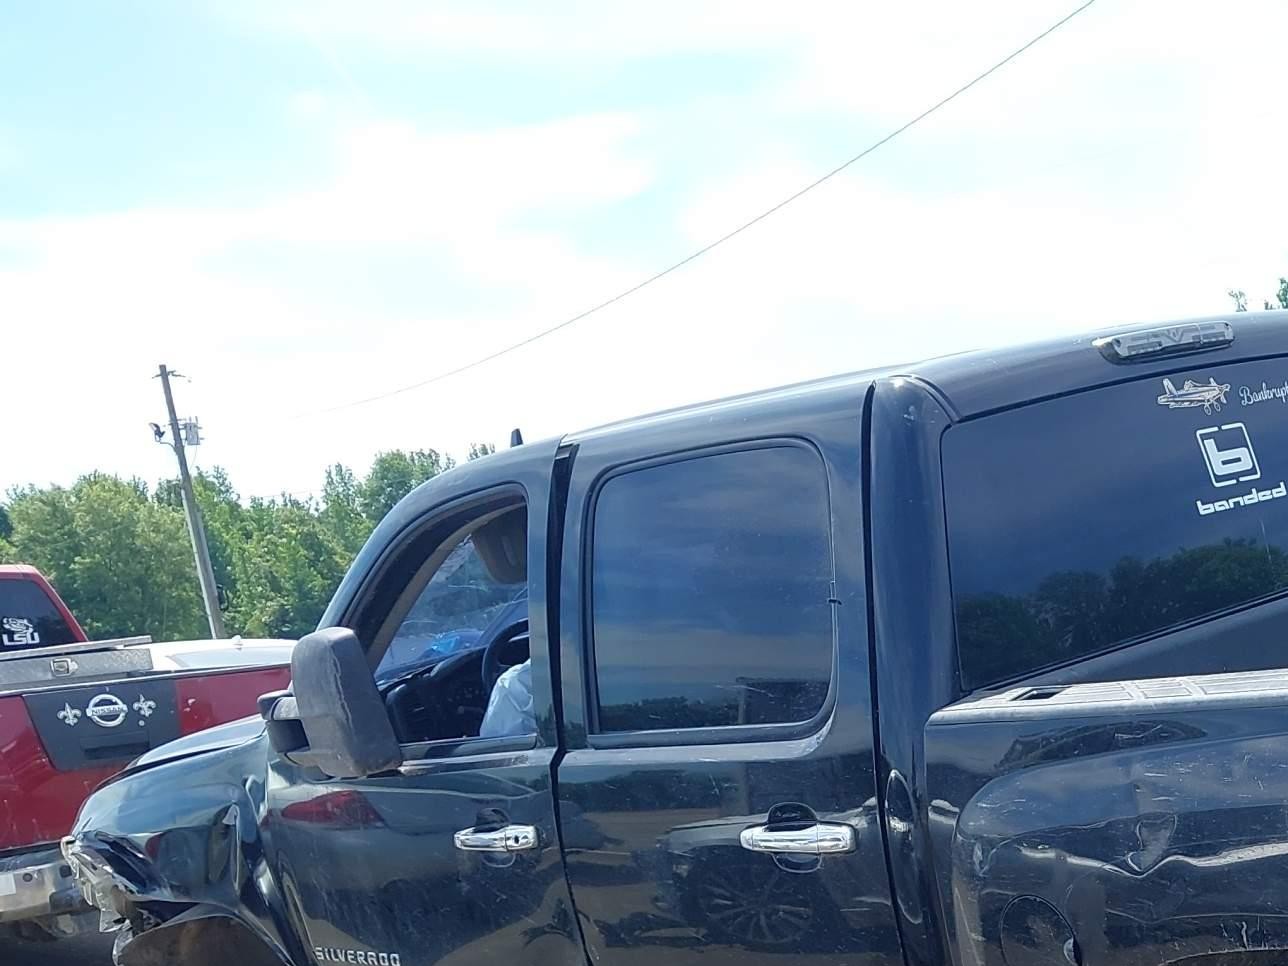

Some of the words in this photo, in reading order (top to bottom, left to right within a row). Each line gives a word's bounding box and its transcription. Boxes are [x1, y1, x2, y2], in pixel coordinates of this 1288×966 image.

[1203, 438, 1254, 476] b
[1196, 481, 1288, 515] banded
[2, 632, 40, 646] LSU
